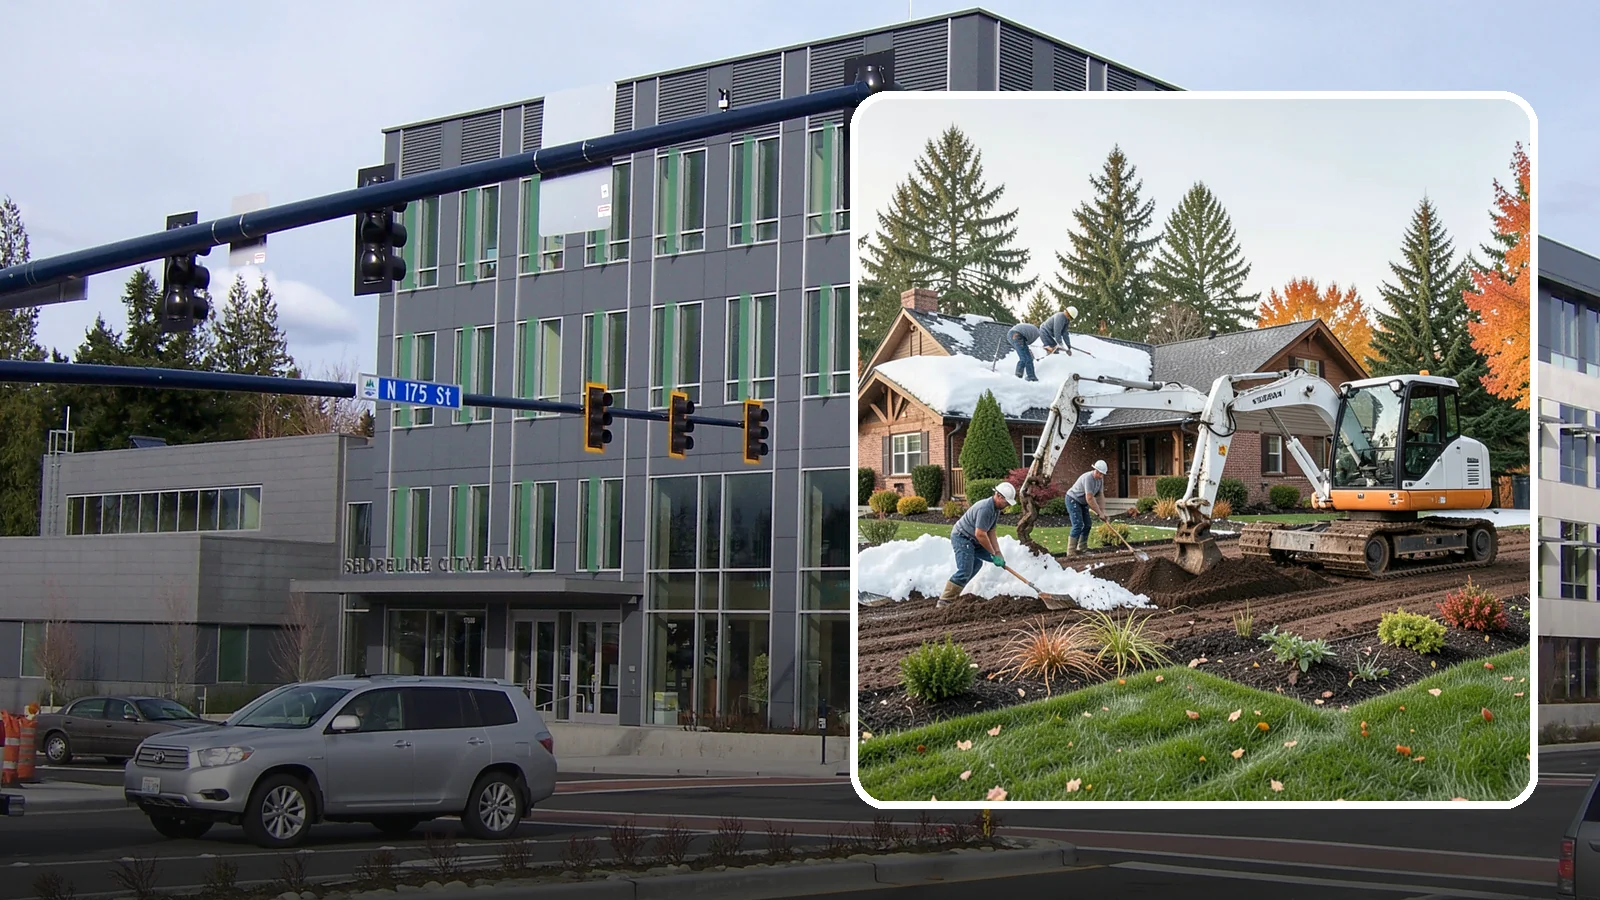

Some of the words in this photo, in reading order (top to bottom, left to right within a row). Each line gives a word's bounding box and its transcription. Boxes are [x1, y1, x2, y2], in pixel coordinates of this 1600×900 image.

[387, 380, 396, 400] N
[405, 382, 428, 403] 175
[436, 386, 452, 406] St
[343, 556, 432, 574] SHORELINE
[438, 556, 476, 572] CITY
[484, 555, 526, 572] HALL
